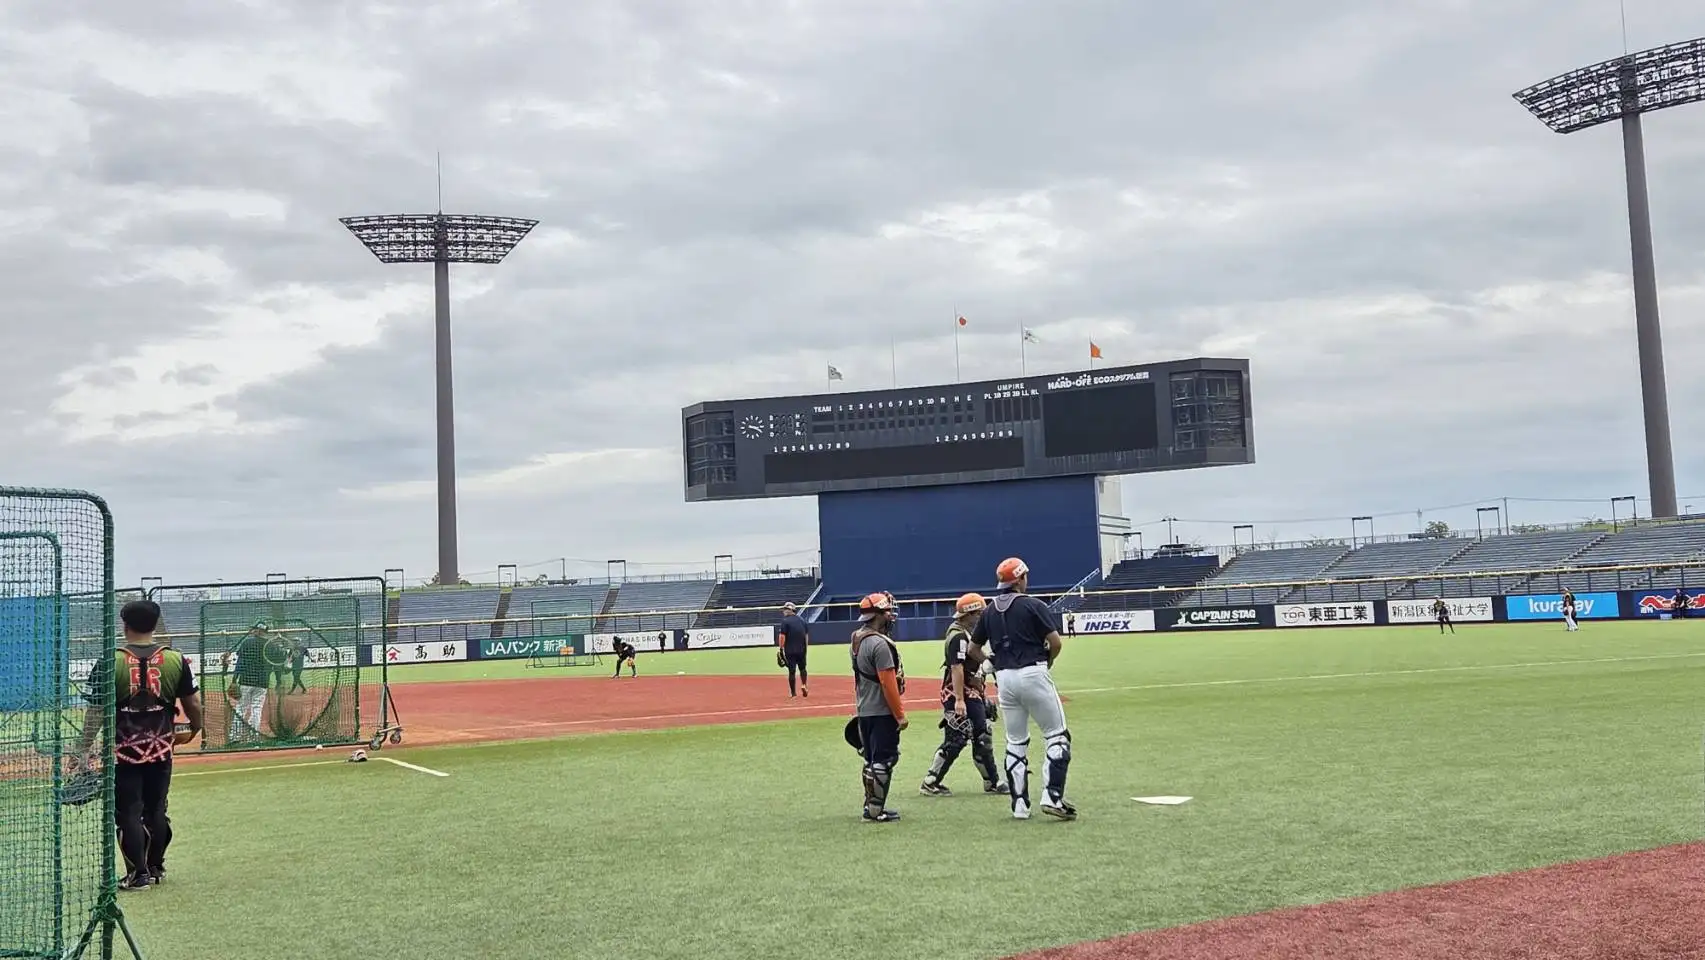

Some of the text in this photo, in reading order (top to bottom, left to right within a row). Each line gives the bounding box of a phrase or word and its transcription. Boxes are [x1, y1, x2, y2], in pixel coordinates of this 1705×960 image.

[997, 383, 1025, 391] UMPIRE
[1191, 609, 1256, 620] CAPTAIN STAG
[1308, 605, 1368, 621] 東亜工業
[1084, 620, 1131, 631] INPEX
[485, 640, 540, 656] JAバンク
